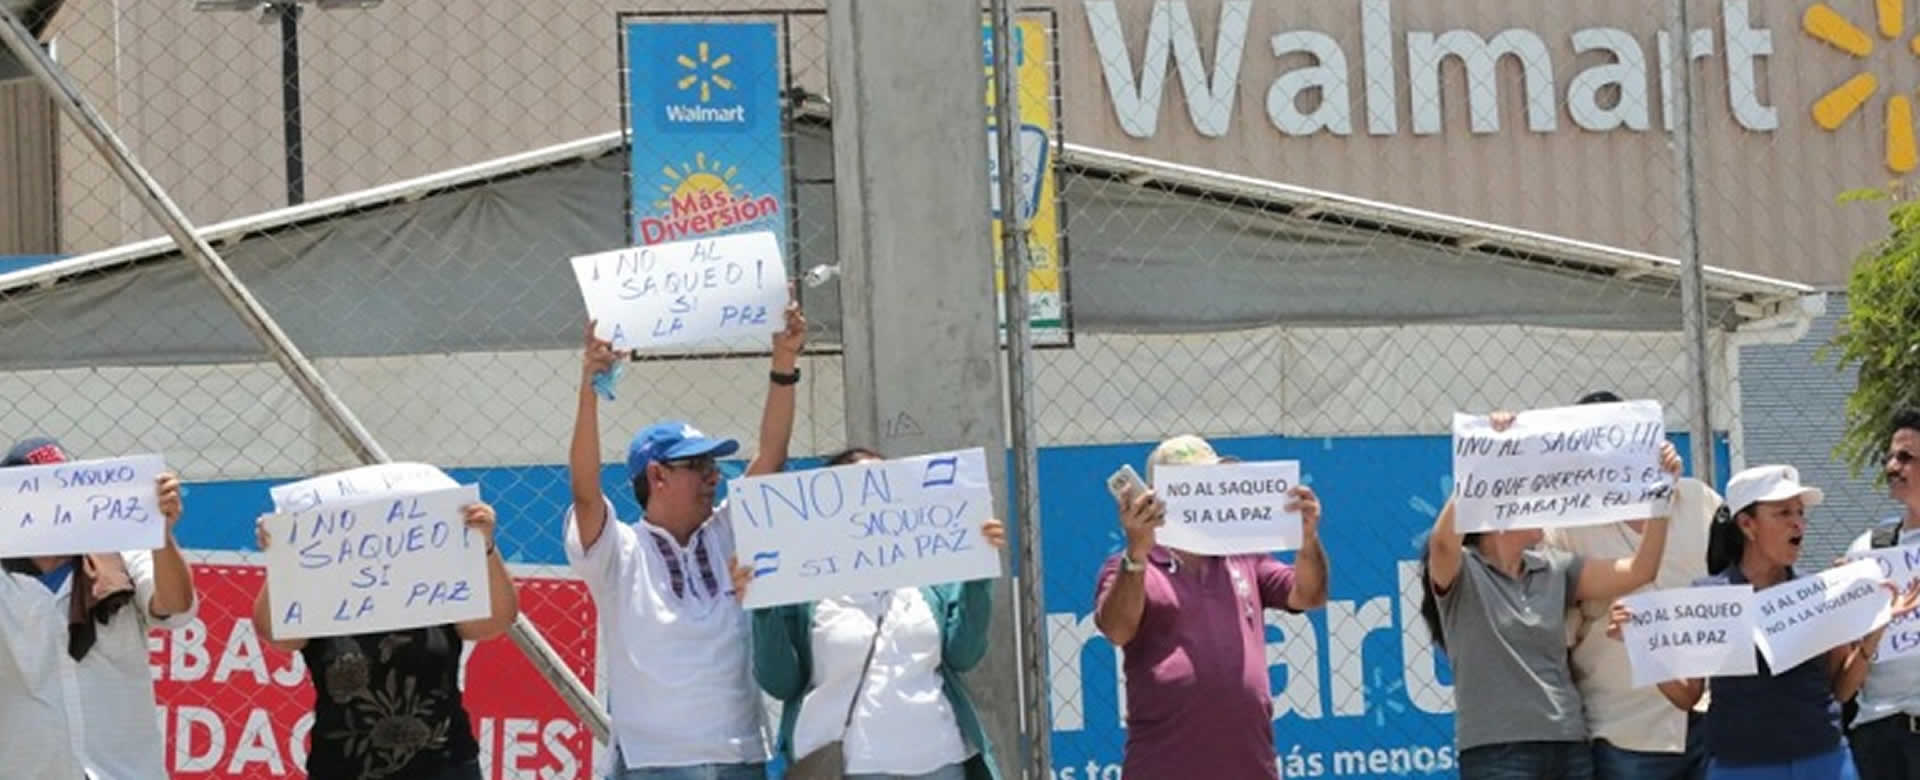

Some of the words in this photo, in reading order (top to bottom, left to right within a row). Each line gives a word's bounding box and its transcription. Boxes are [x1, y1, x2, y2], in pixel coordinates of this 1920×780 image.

[1083, 0, 1779, 137] Walmart
[665, 104, 745, 123] Walmart
[671, 188, 727, 219] Más
[641, 194, 778, 246] Diversión
[690, 240, 723, 264] AL
[612, 323, 625, 343] A
[652, 317, 684, 338] LA
[720, 304, 768, 328] PAZ
[1498, 437, 1524, 458] AL
[1167, 483, 1191, 497] NO
[1194, 481, 1215, 496] AL
[1219, 479, 1288, 496] SAQUEO
[1491, 476, 1528, 498] QUE
[1602, 490, 1631, 506] EN
[86, 495, 149, 523] PAZ
[386, 499, 427, 524] AL
[1183, 509, 1197, 524] SI
[1200, 508, 1213, 523] A
[1217, 507, 1237, 523] LA
[1241, 506, 1273, 522] PAZ
[800, 555, 840, 577] SI
[914, 529, 976, 559] PAZ
[351, 564, 390, 589] SI
[284, 601, 303, 624] A
[333, 595, 375, 621] LA
[405, 580, 470, 608] PAZ
[1766, 621, 1786, 635] NO
[1788, 617, 1798, 626] A
[1799, 609, 1814, 622] LA
[1815, 583, 1875, 614] VIOLENCIA
[1778, 594, 1796, 609] AL
[1632, 609, 1653, 627] NO
[1655, 608, 1670, 621] AL
[1674, 602, 1743, 619] SAQUEO
[1661, 633, 1671, 647] A
[1672, 631, 1693, 646] LA
[1696, 629, 1727, 645] PAZ
